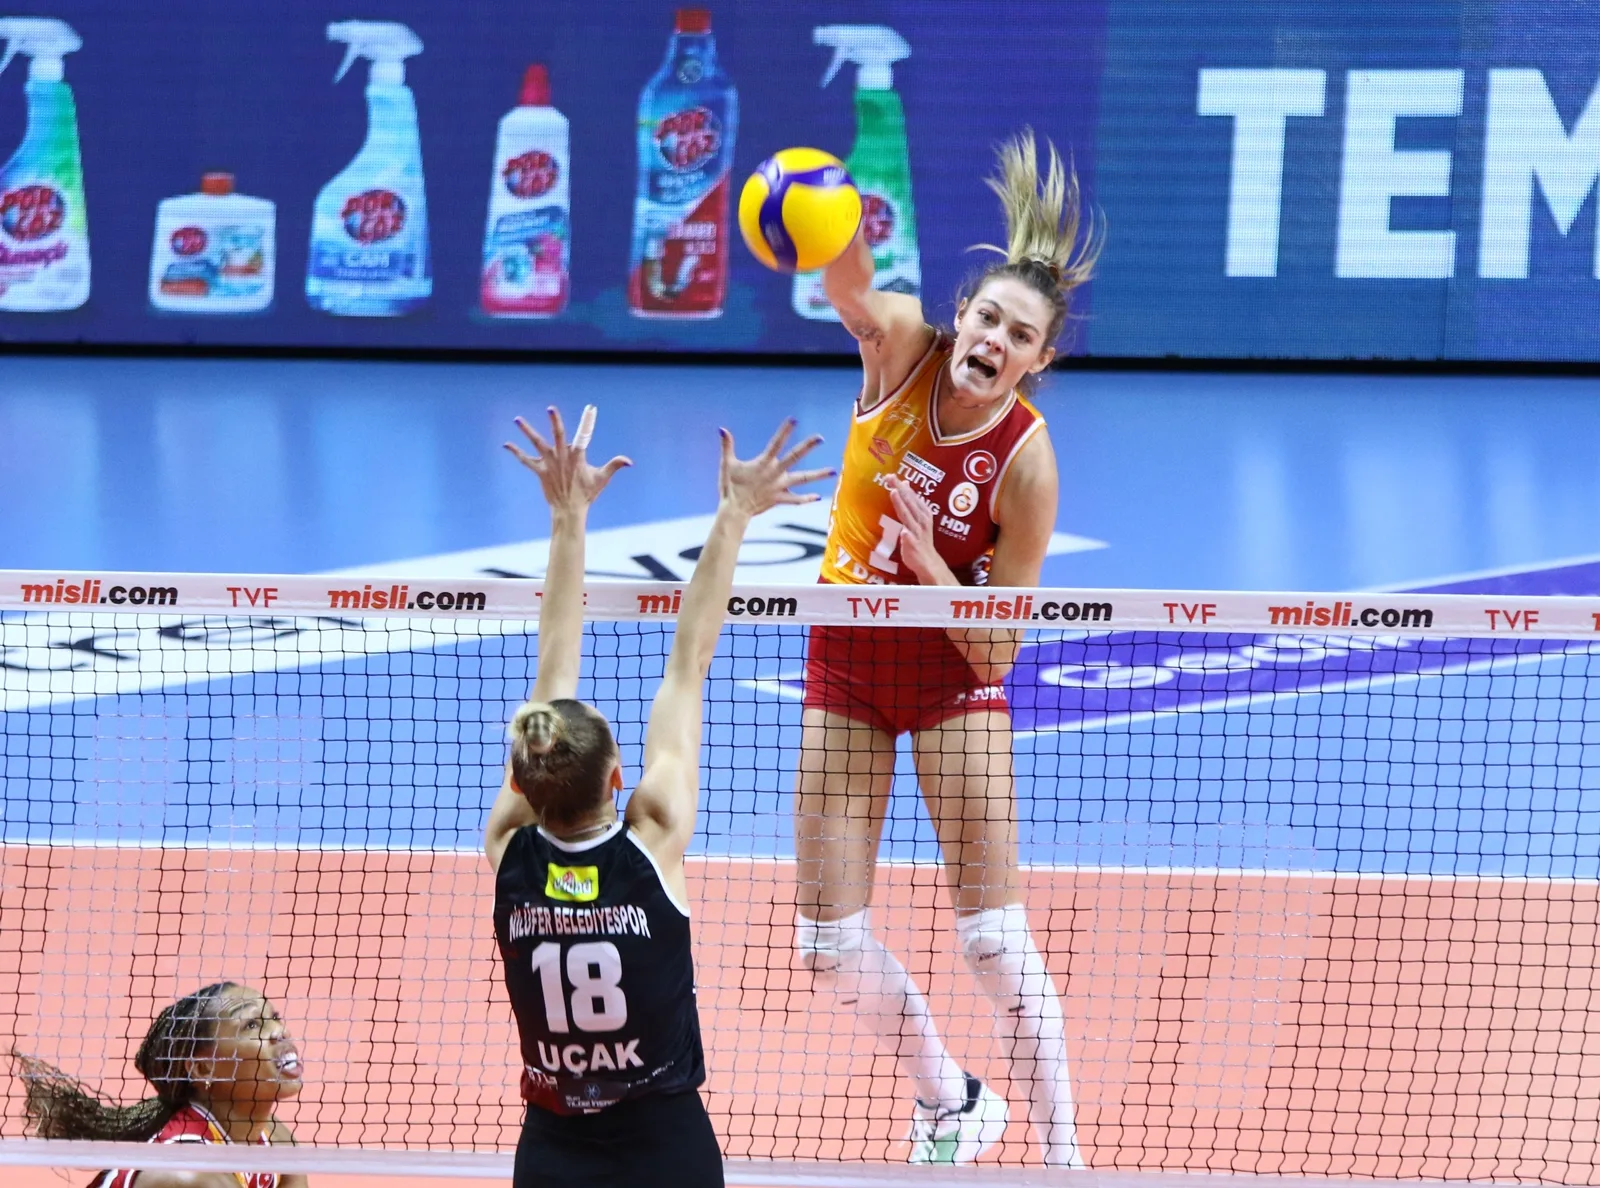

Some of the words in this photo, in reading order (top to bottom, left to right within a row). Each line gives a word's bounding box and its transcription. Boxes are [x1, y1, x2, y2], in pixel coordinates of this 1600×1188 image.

[1196, 67, 1600, 280] TEM
[940, 514, 971, 536] HDI
[21, 579, 178, 606] misli.com
[226, 587, 279, 608] TVF
[328, 585, 486, 611] misli.com
[847, 597, 900, 619] TVF
[949, 595, 1113, 622] misli.com
[1163, 602, 1217, 624] TVF
[1268, 601, 1434, 628] misli.com
[1484, 609, 1539, 631] TVF
[554, 902, 652, 940] BELEDİYESPOR
[531, 941, 628, 1033] 18
[537, 1038, 645, 1078] UÇAK
